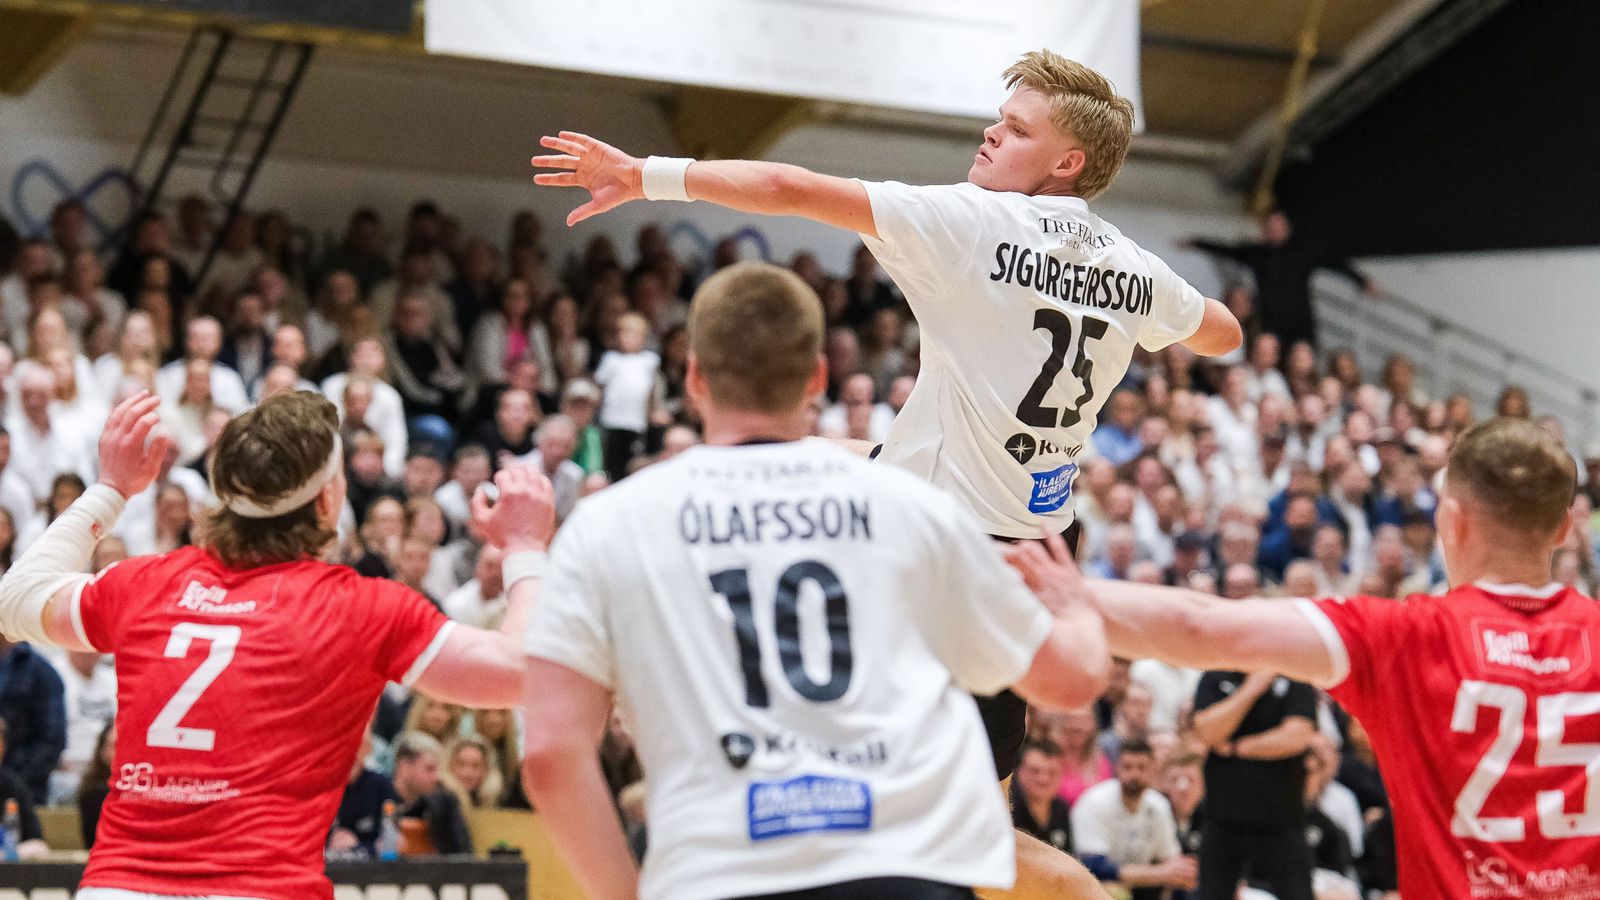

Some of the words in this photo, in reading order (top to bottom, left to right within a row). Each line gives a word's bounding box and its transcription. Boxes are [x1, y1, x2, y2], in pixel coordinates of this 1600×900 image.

[990, 242, 1153, 316] SIGURGEIRSSON
[1016, 308, 1109, 428] 25
[680, 494, 872, 544] ÓLAFSSON
[146, 621, 242, 752] 2
[709, 559, 854, 709] 10
[1450, 679, 1600, 842] 25
